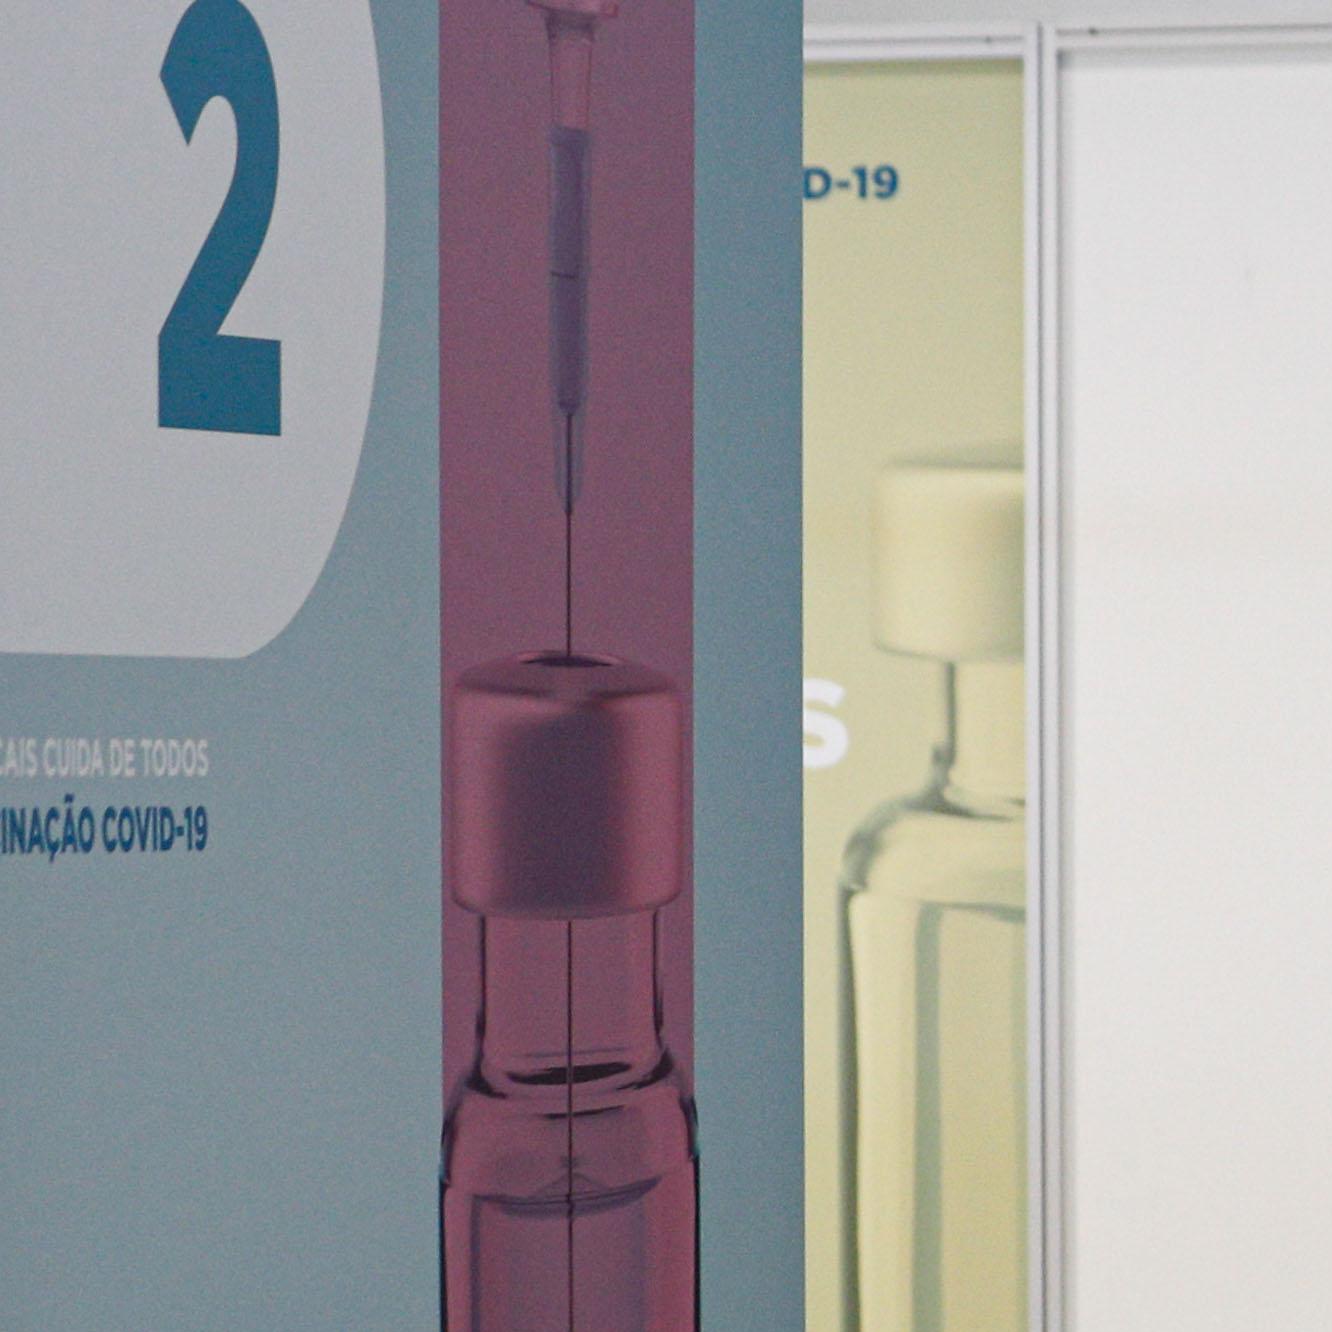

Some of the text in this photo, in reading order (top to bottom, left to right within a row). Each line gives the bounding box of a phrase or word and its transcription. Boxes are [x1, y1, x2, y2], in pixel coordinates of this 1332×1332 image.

[157, 0, 282, 437] 2
[43, 738, 103, 777] CUIDA
[109, 738, 136, 777] DE
[140, 739, 209, 777] TODOS
[102, 805, 208, 853] COVID-19
